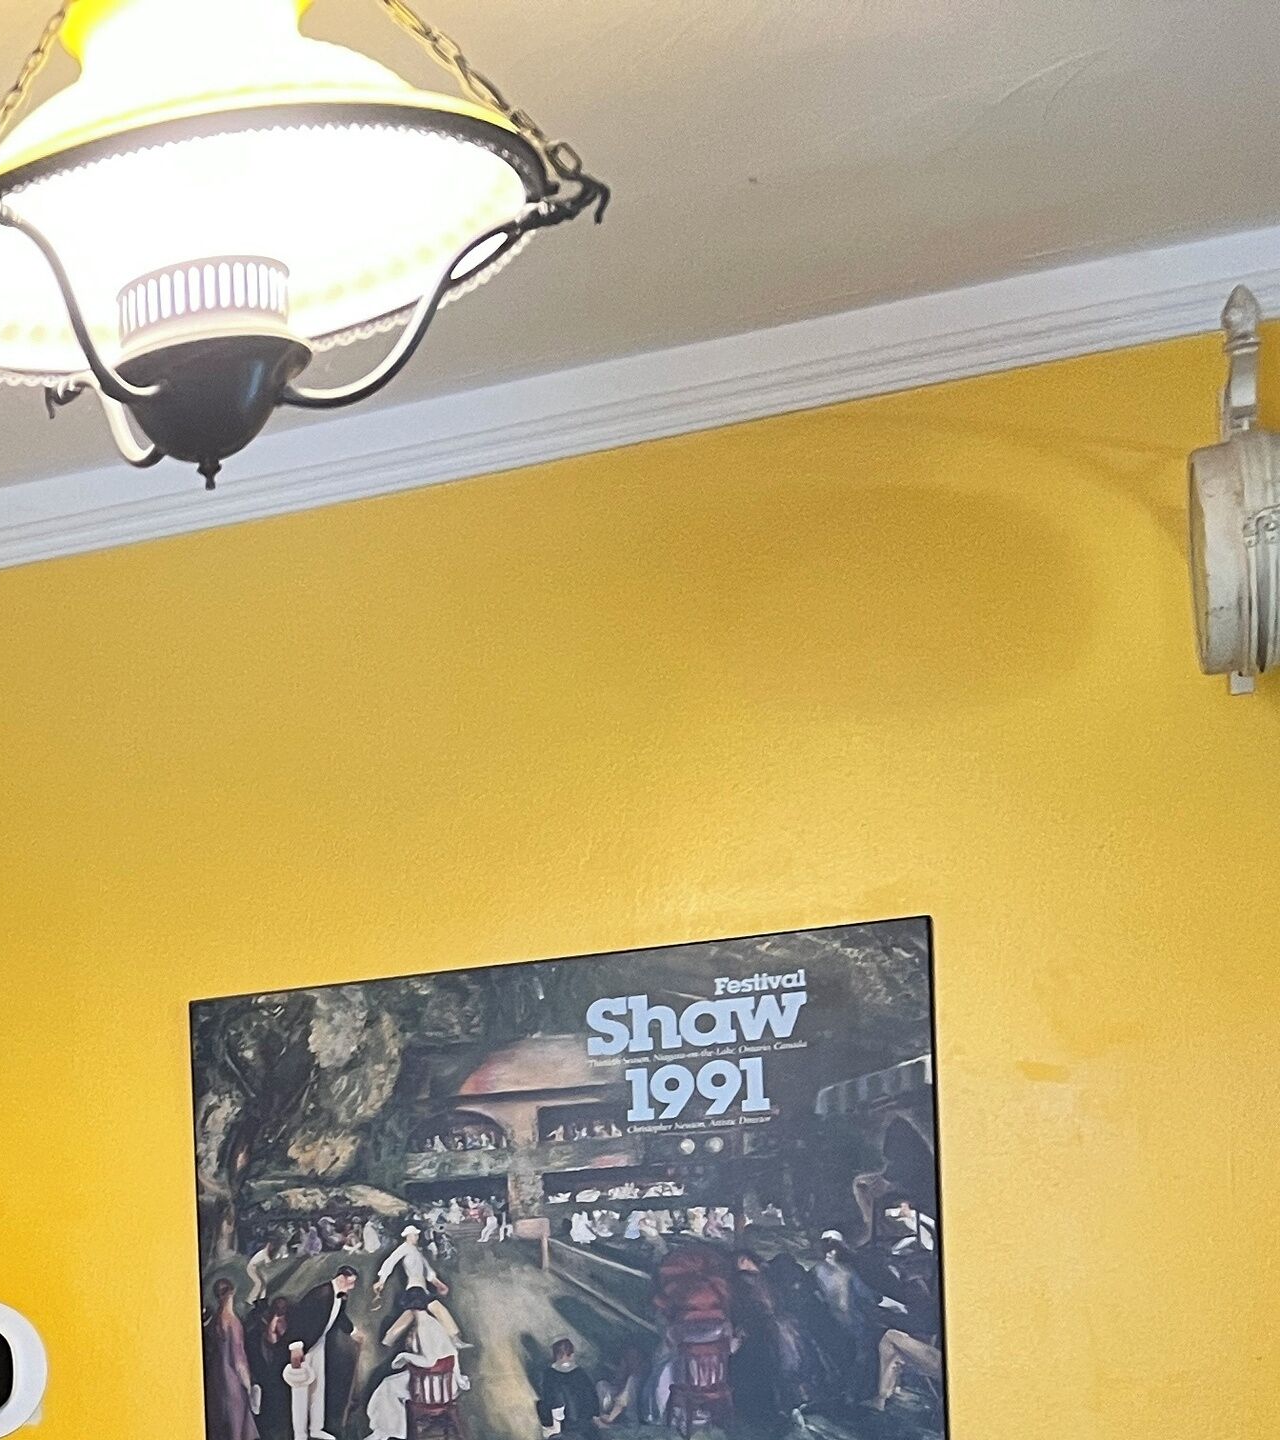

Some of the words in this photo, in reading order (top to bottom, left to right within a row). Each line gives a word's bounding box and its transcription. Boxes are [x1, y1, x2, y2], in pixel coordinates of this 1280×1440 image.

[713, 968, 806, 996] Festival
[585, 991, 808, 1056] Shaw
[625, 1056, 771, 1122] 1991
